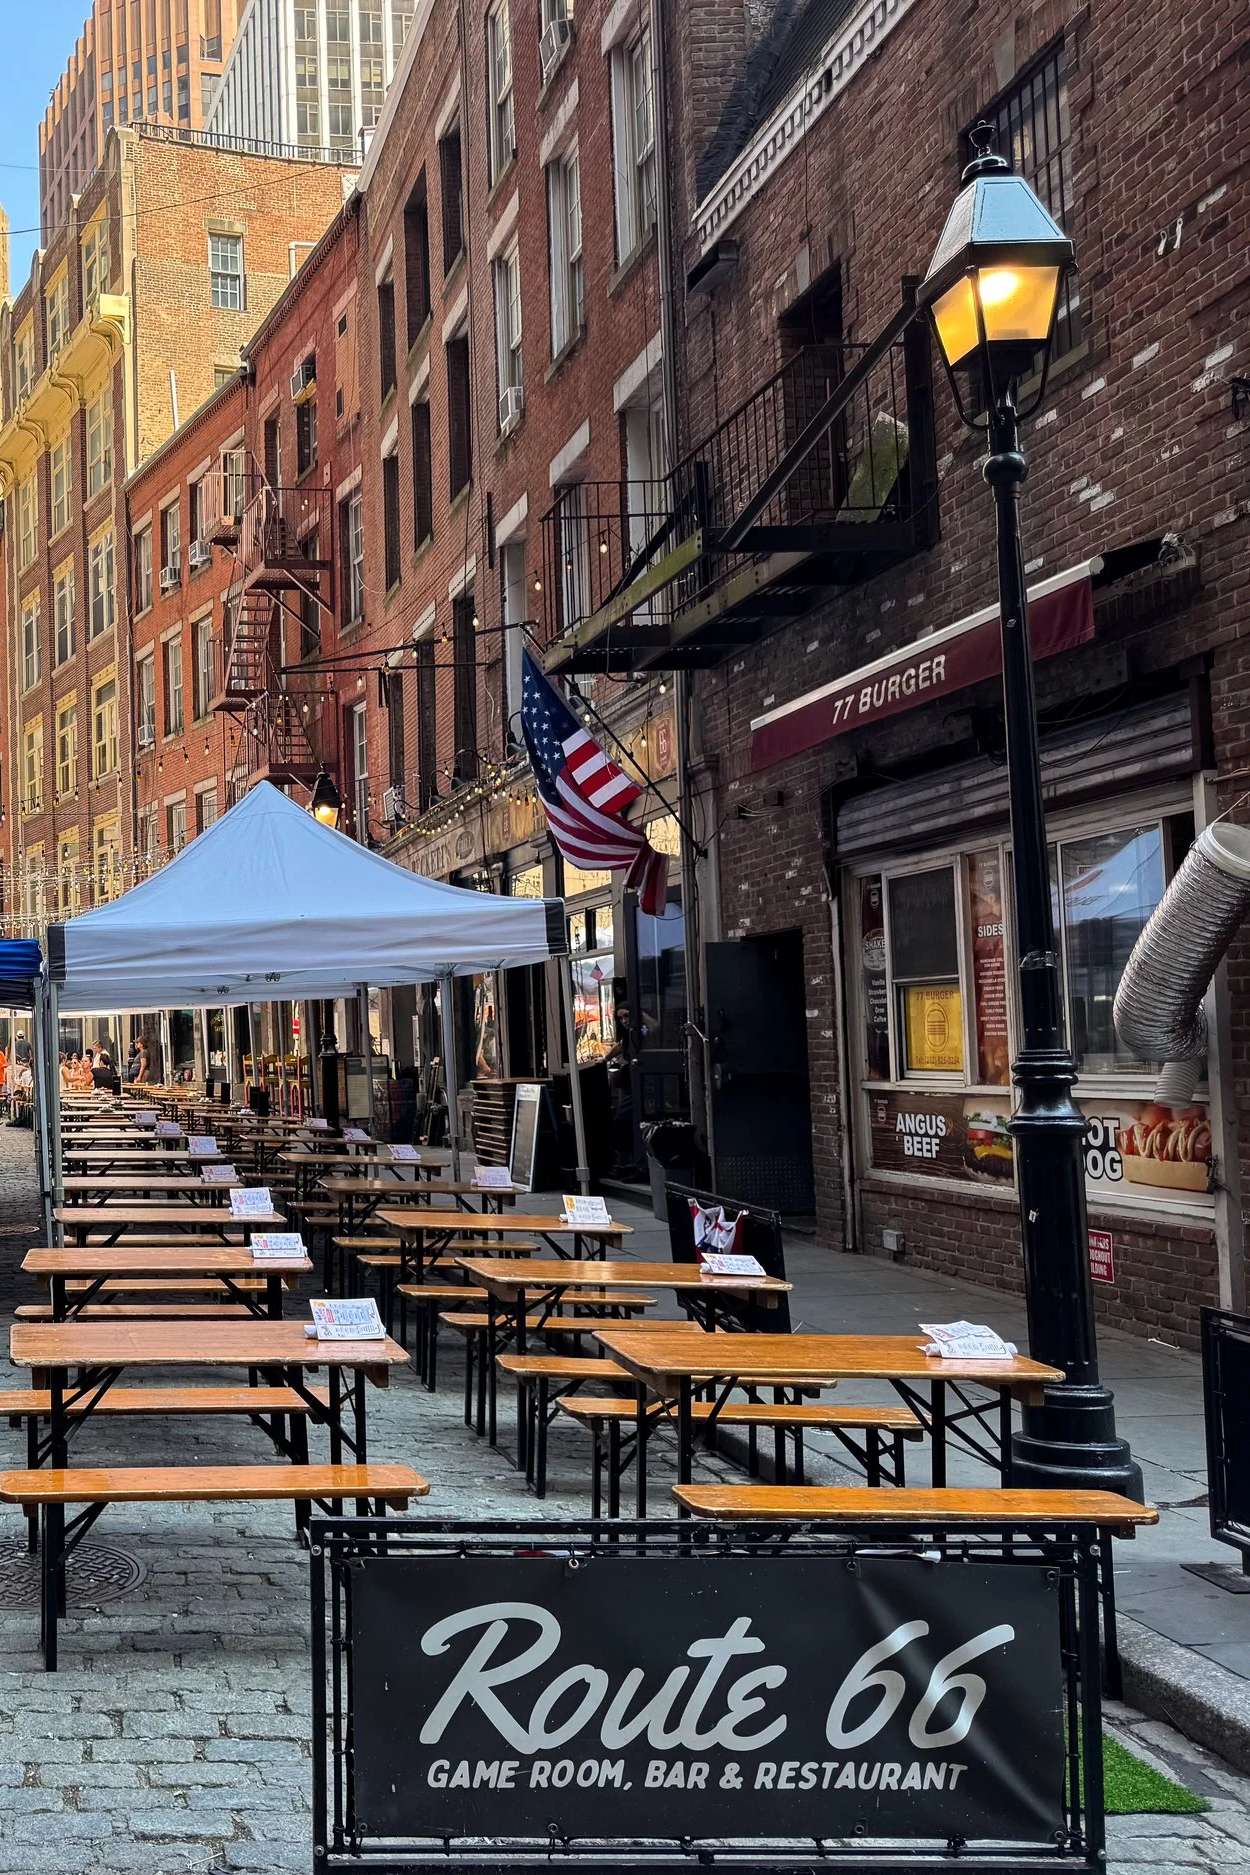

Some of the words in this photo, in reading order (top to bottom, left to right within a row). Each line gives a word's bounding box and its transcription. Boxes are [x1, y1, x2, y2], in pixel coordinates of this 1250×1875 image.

[832, 694, 855, 725] 77
[858, 654, 946, 714] BURGER
[865, 938, 886, 950] SHAKE
[977, 923, 1004, 938] SIDES
[916, 991, 924, 1001] 77
[925, 990, 955, 1000] BURGER
[895, 1112, 947, 1137] ANGUS
[1082, 1116, 1120, 1148] OT
[903, 1135, 940, 1159] BEEF
[1083, 1148, 1123, 1181] OG
[419, 1602, 788, 1755] Route
[825, 1619, 1015, 1750] 66
[427, 1759, 520, 1789] GAME
[529, 1759, 633, 1791] ROOM,
[644, 1760, 710, 1790] BAR
[719, 1761, 744, 1790] &
[754, 1760, 968, 1791] RESTAURANT
